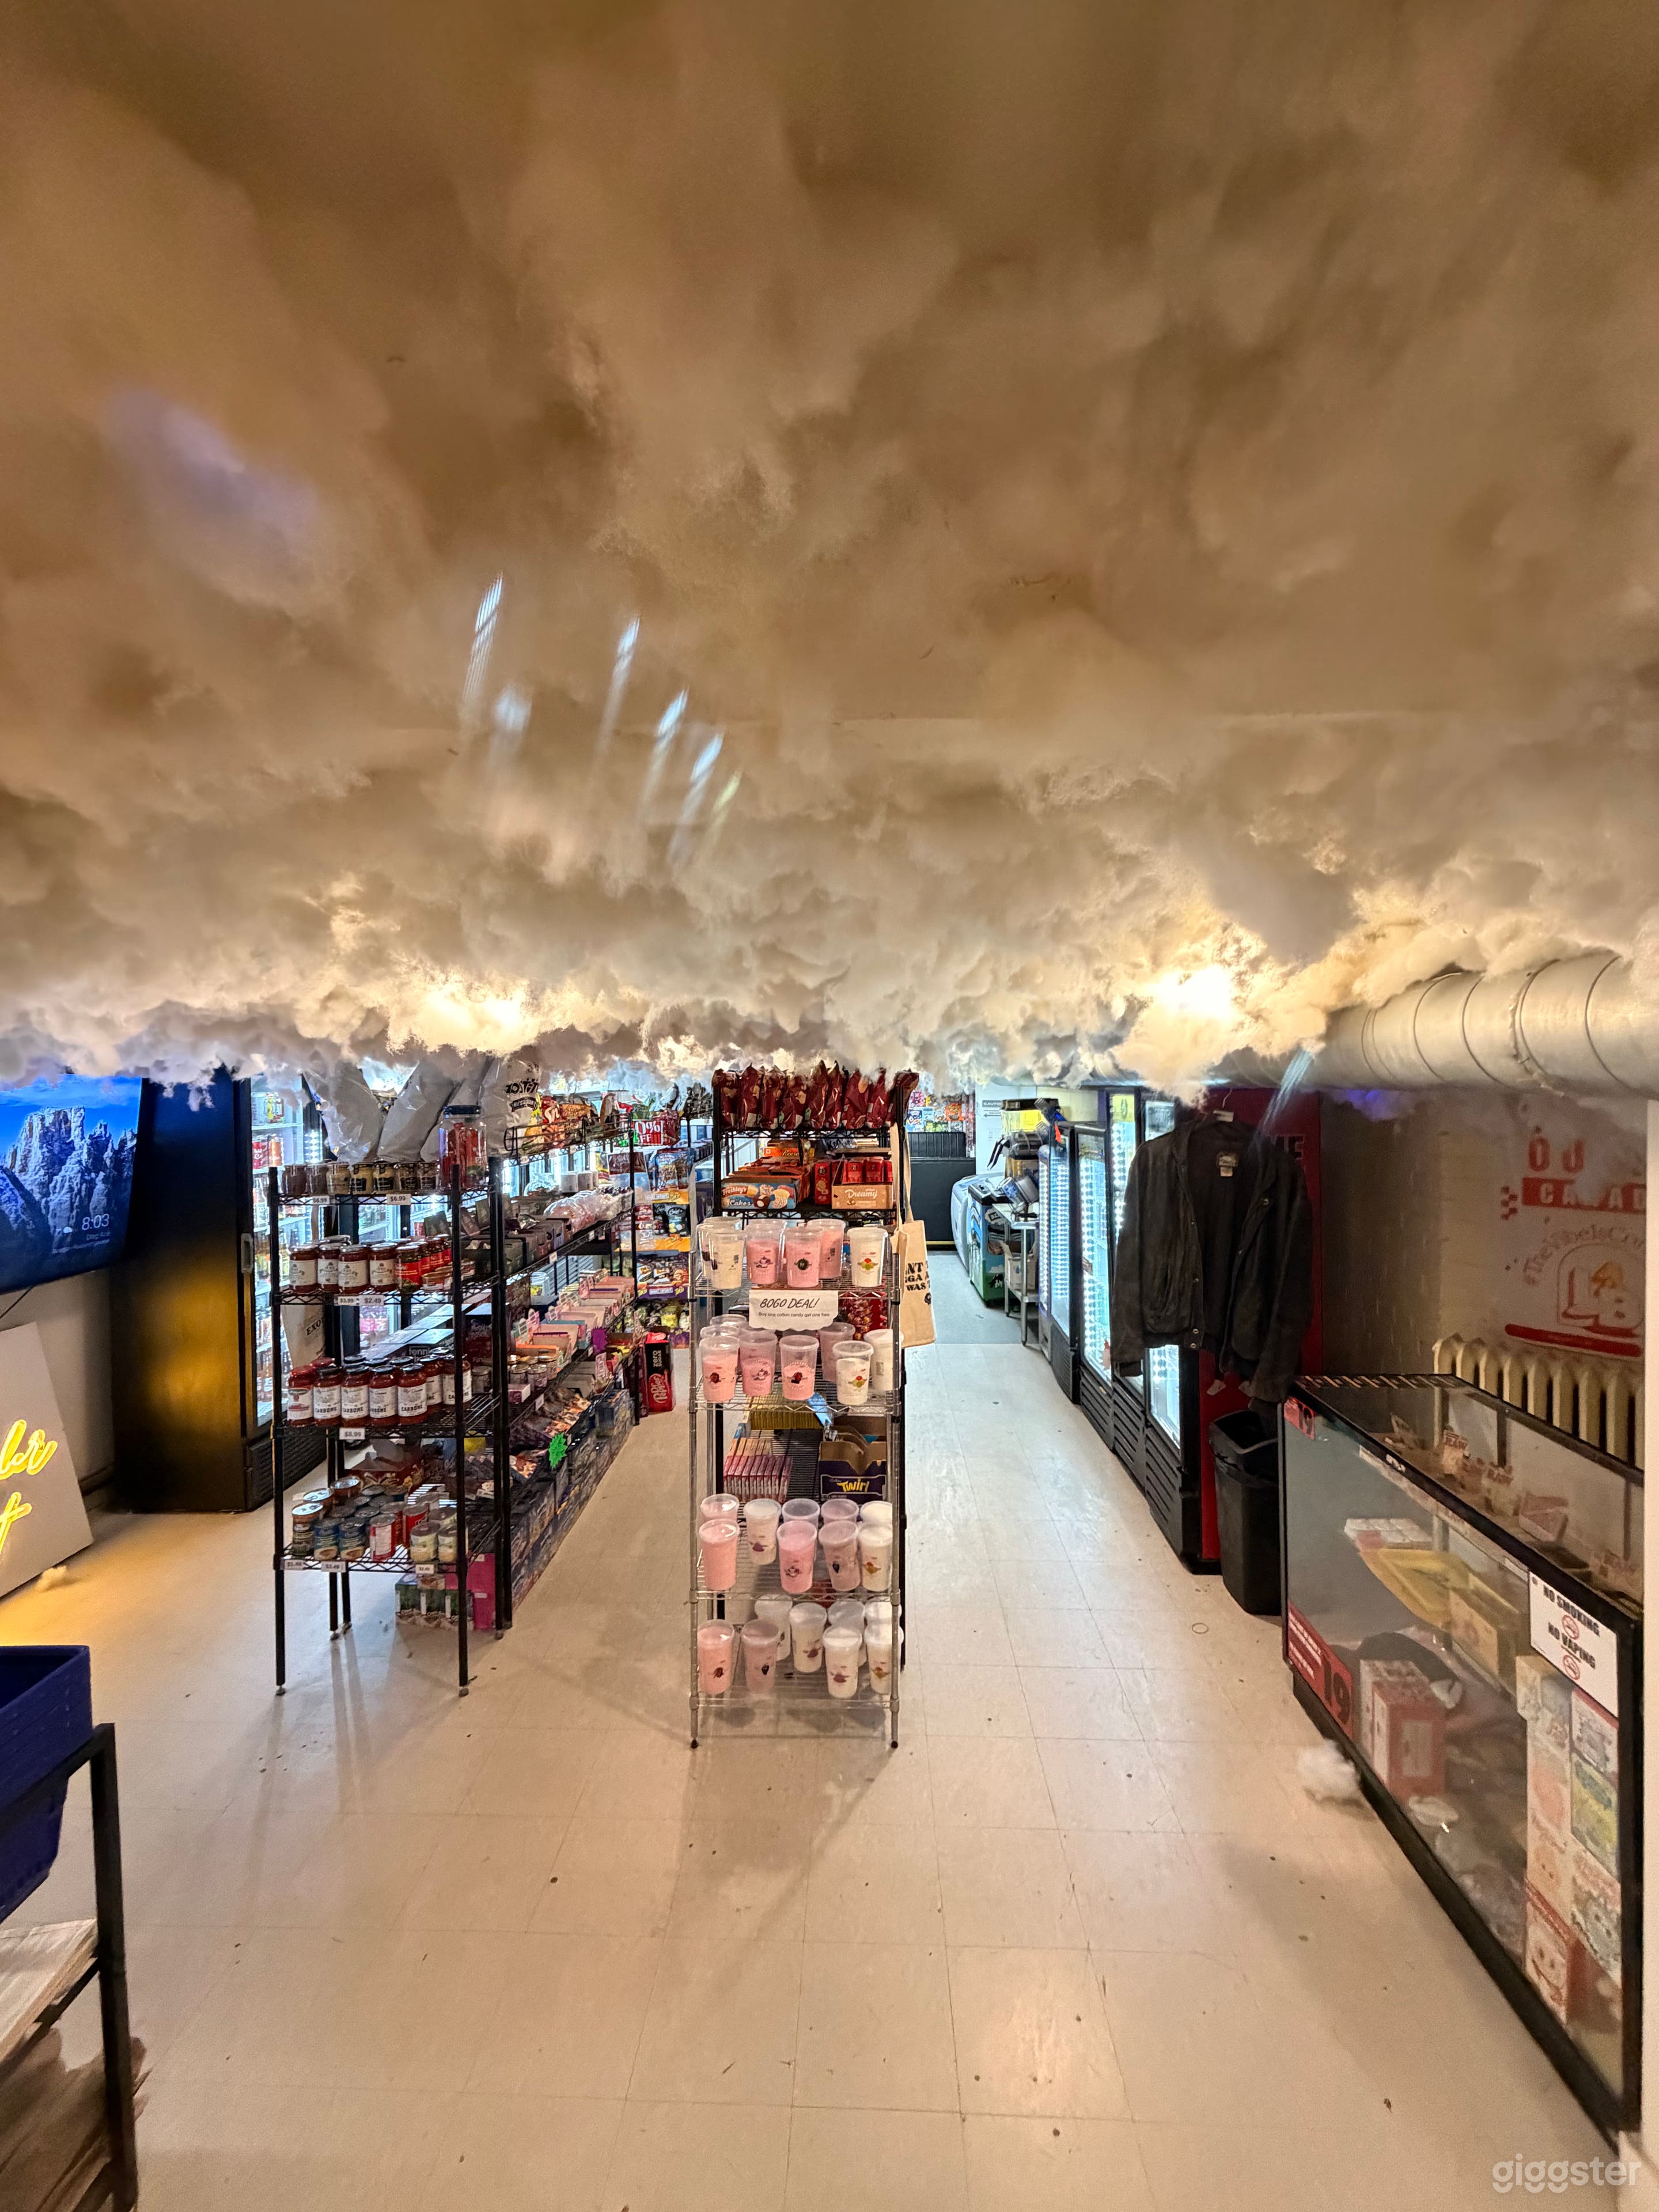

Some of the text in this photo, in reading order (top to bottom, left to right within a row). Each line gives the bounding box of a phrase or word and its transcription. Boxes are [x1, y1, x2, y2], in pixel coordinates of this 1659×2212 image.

[844, 1189, 878, 1199] Dreamy
[82, 1213, 110, 1230] 8:03
[760, 1298, 820, 1309] BOGO DEAL!
[1544, 1585, 1600, 1638] NO SMOKING
[1548, 1622, 1596, 1670] NO VAPING
